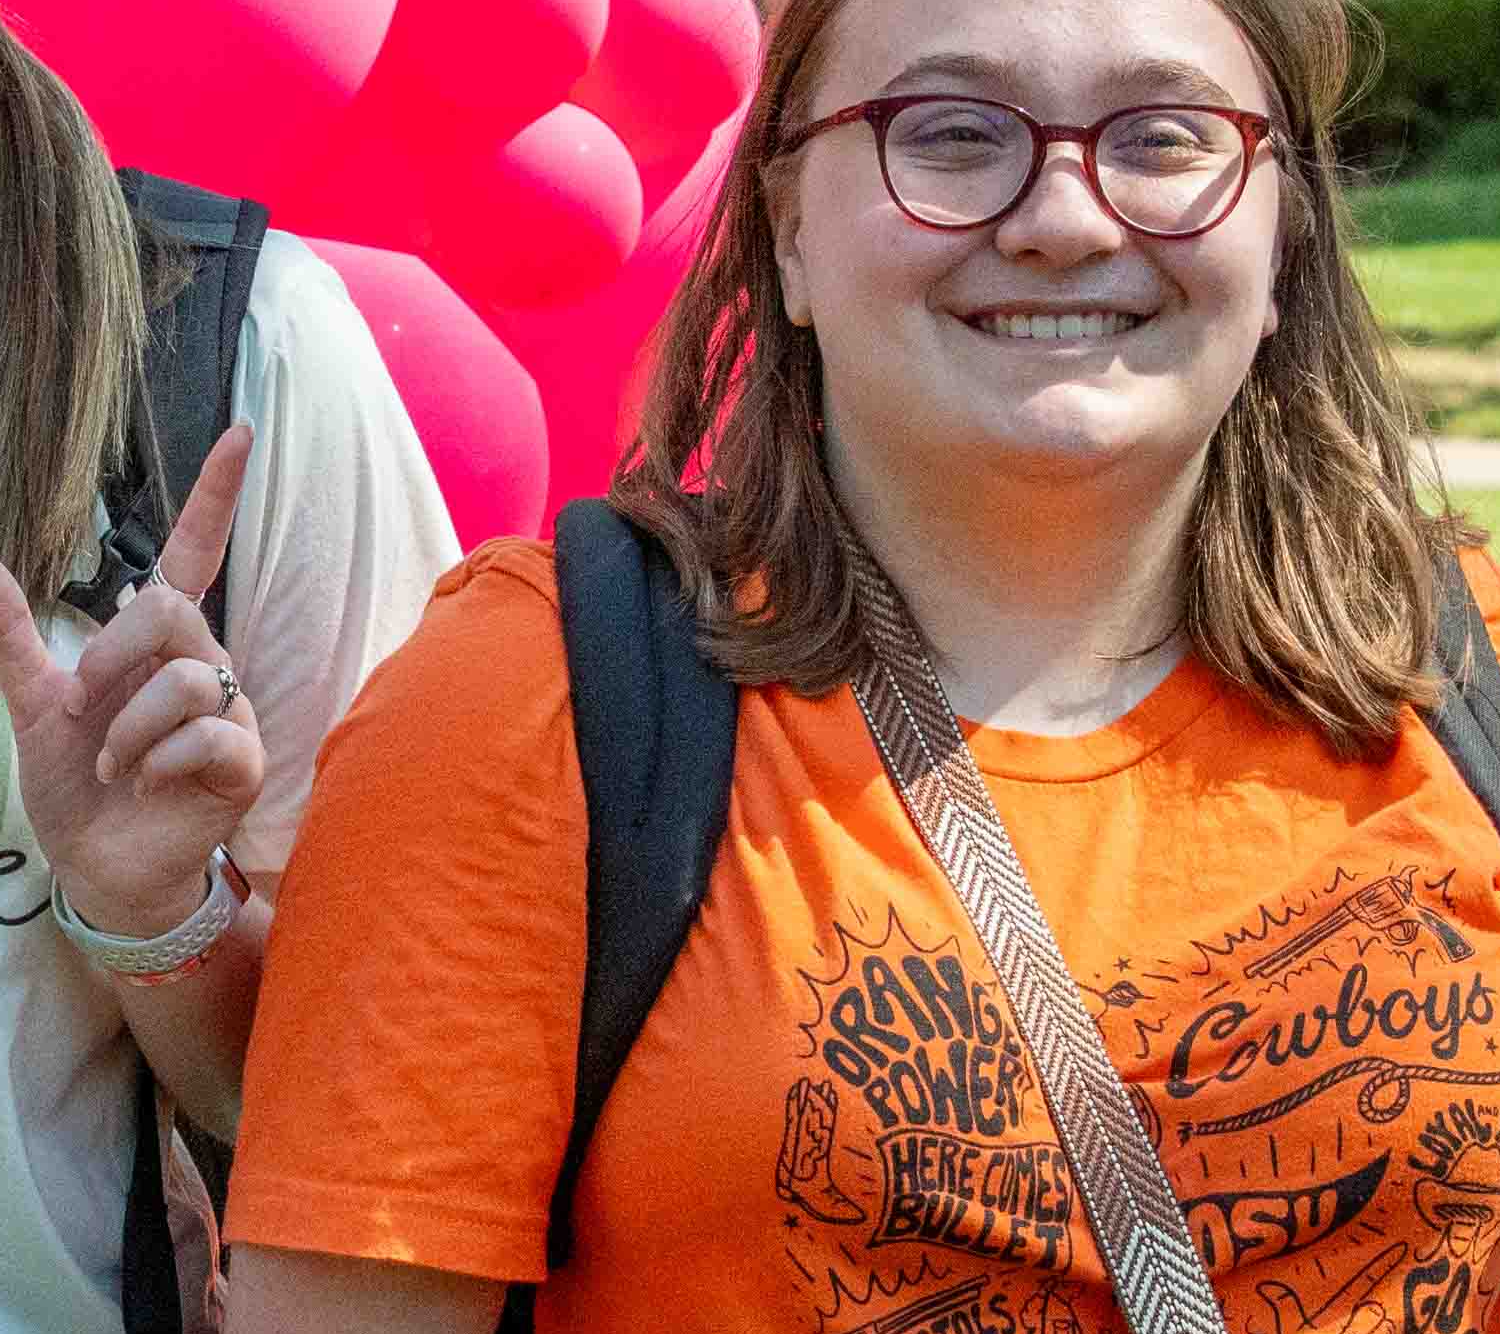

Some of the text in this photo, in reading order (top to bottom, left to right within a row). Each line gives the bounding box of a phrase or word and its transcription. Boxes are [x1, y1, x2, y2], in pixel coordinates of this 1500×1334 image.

[1165, 963, 1496, 1099] Cowboys
[863, 1039, 1023, 1136] POWER
[890, 1136, 1069, 1223] HERE COMES
[1408, 1098, 1491, 1177] LOYAL
[1477, 1105, 1499, 1118] AND
[885, 1193, 1064, 1269] BULLET
[1188, 1189, 1338, 1273] OSU
